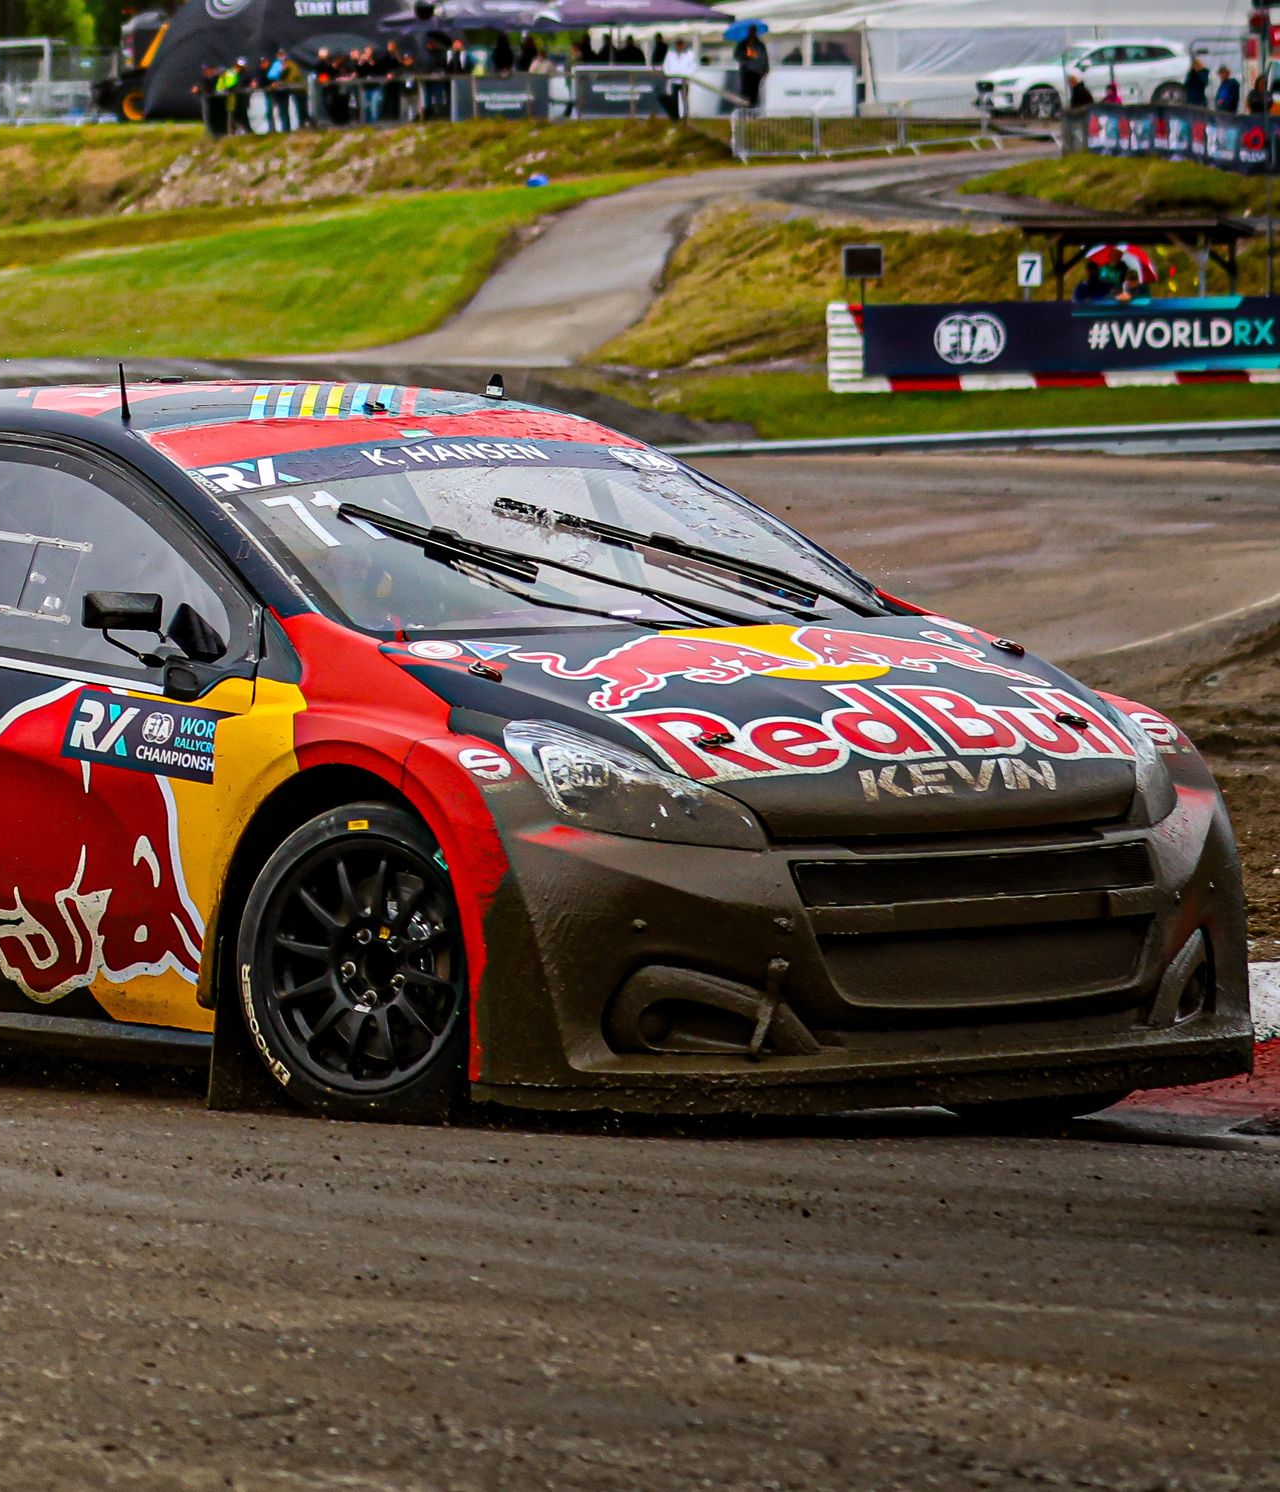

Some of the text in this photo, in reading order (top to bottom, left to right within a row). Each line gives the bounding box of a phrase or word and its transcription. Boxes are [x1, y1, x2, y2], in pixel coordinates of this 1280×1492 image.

[1021, 259, 1037, 287] 7
[1088, 317, 1276, 350] #WORLDRX
[198, 457, 302, 492] RX
[360, 441, 551, 467] K. HANSEN
[260, 489, 388, 548] 71
[69, 698, 141, 757] RX
[608, 682, 1136, 785] Red Bull
[858, 759, 1058, 802] KEVIN
[242, 963, 276, 1066] HOOSIER
